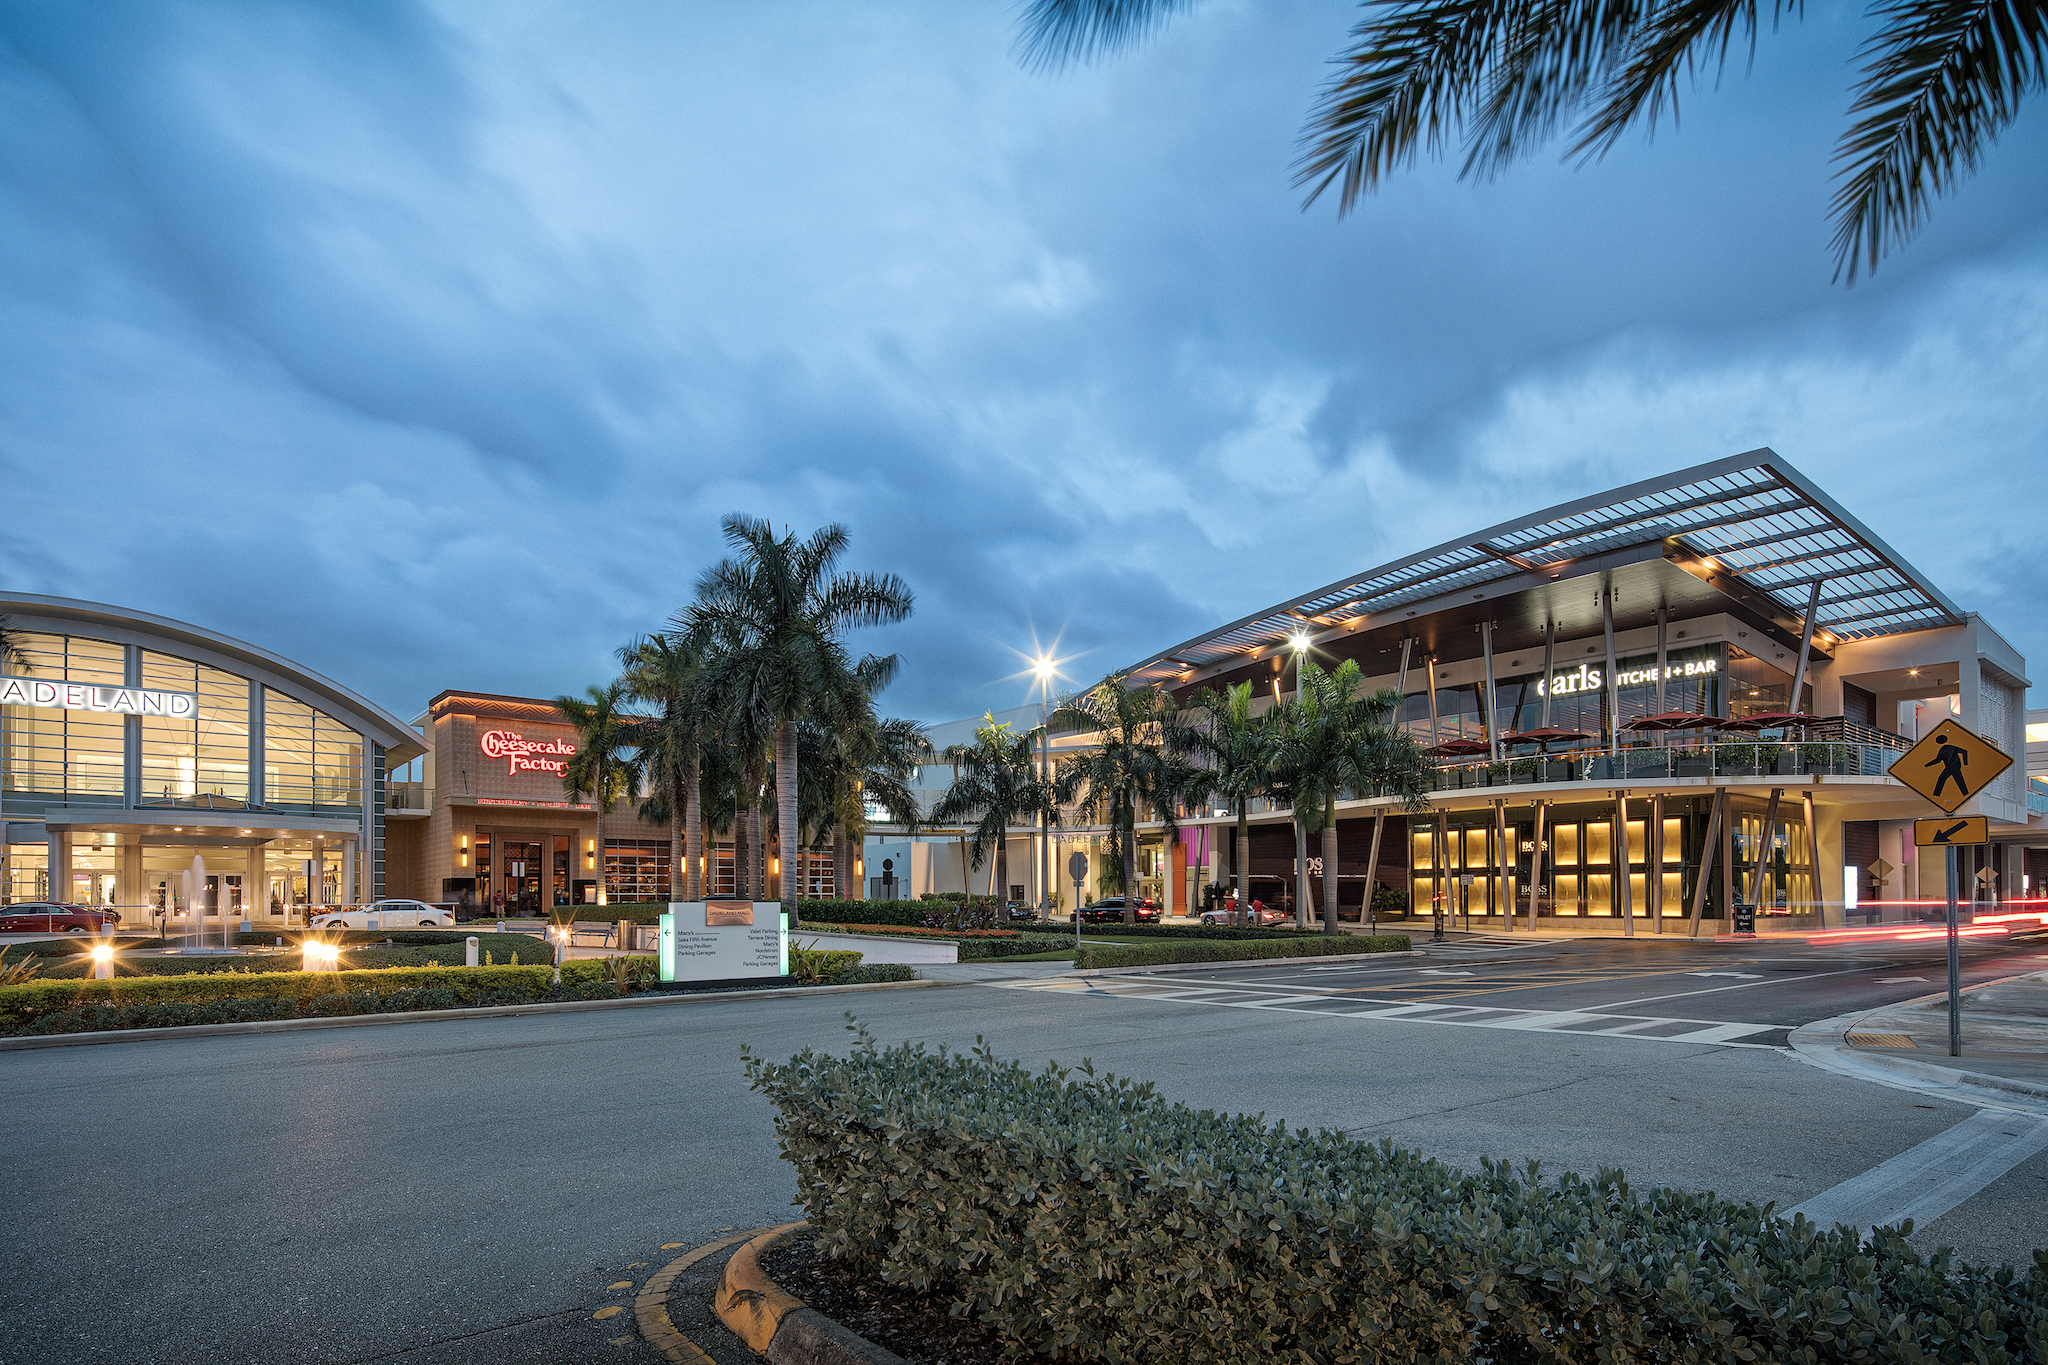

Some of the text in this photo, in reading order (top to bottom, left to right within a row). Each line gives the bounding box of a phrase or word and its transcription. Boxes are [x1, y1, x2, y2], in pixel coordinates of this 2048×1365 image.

[1684, 660, 1717, 676] BAR
[3, 680, 190, 714] ADELAND
[504, 731, 522, 740] The
[481, 730, 576, 758] Cheesecake
[1522, 841, 1548, 849] BOS
